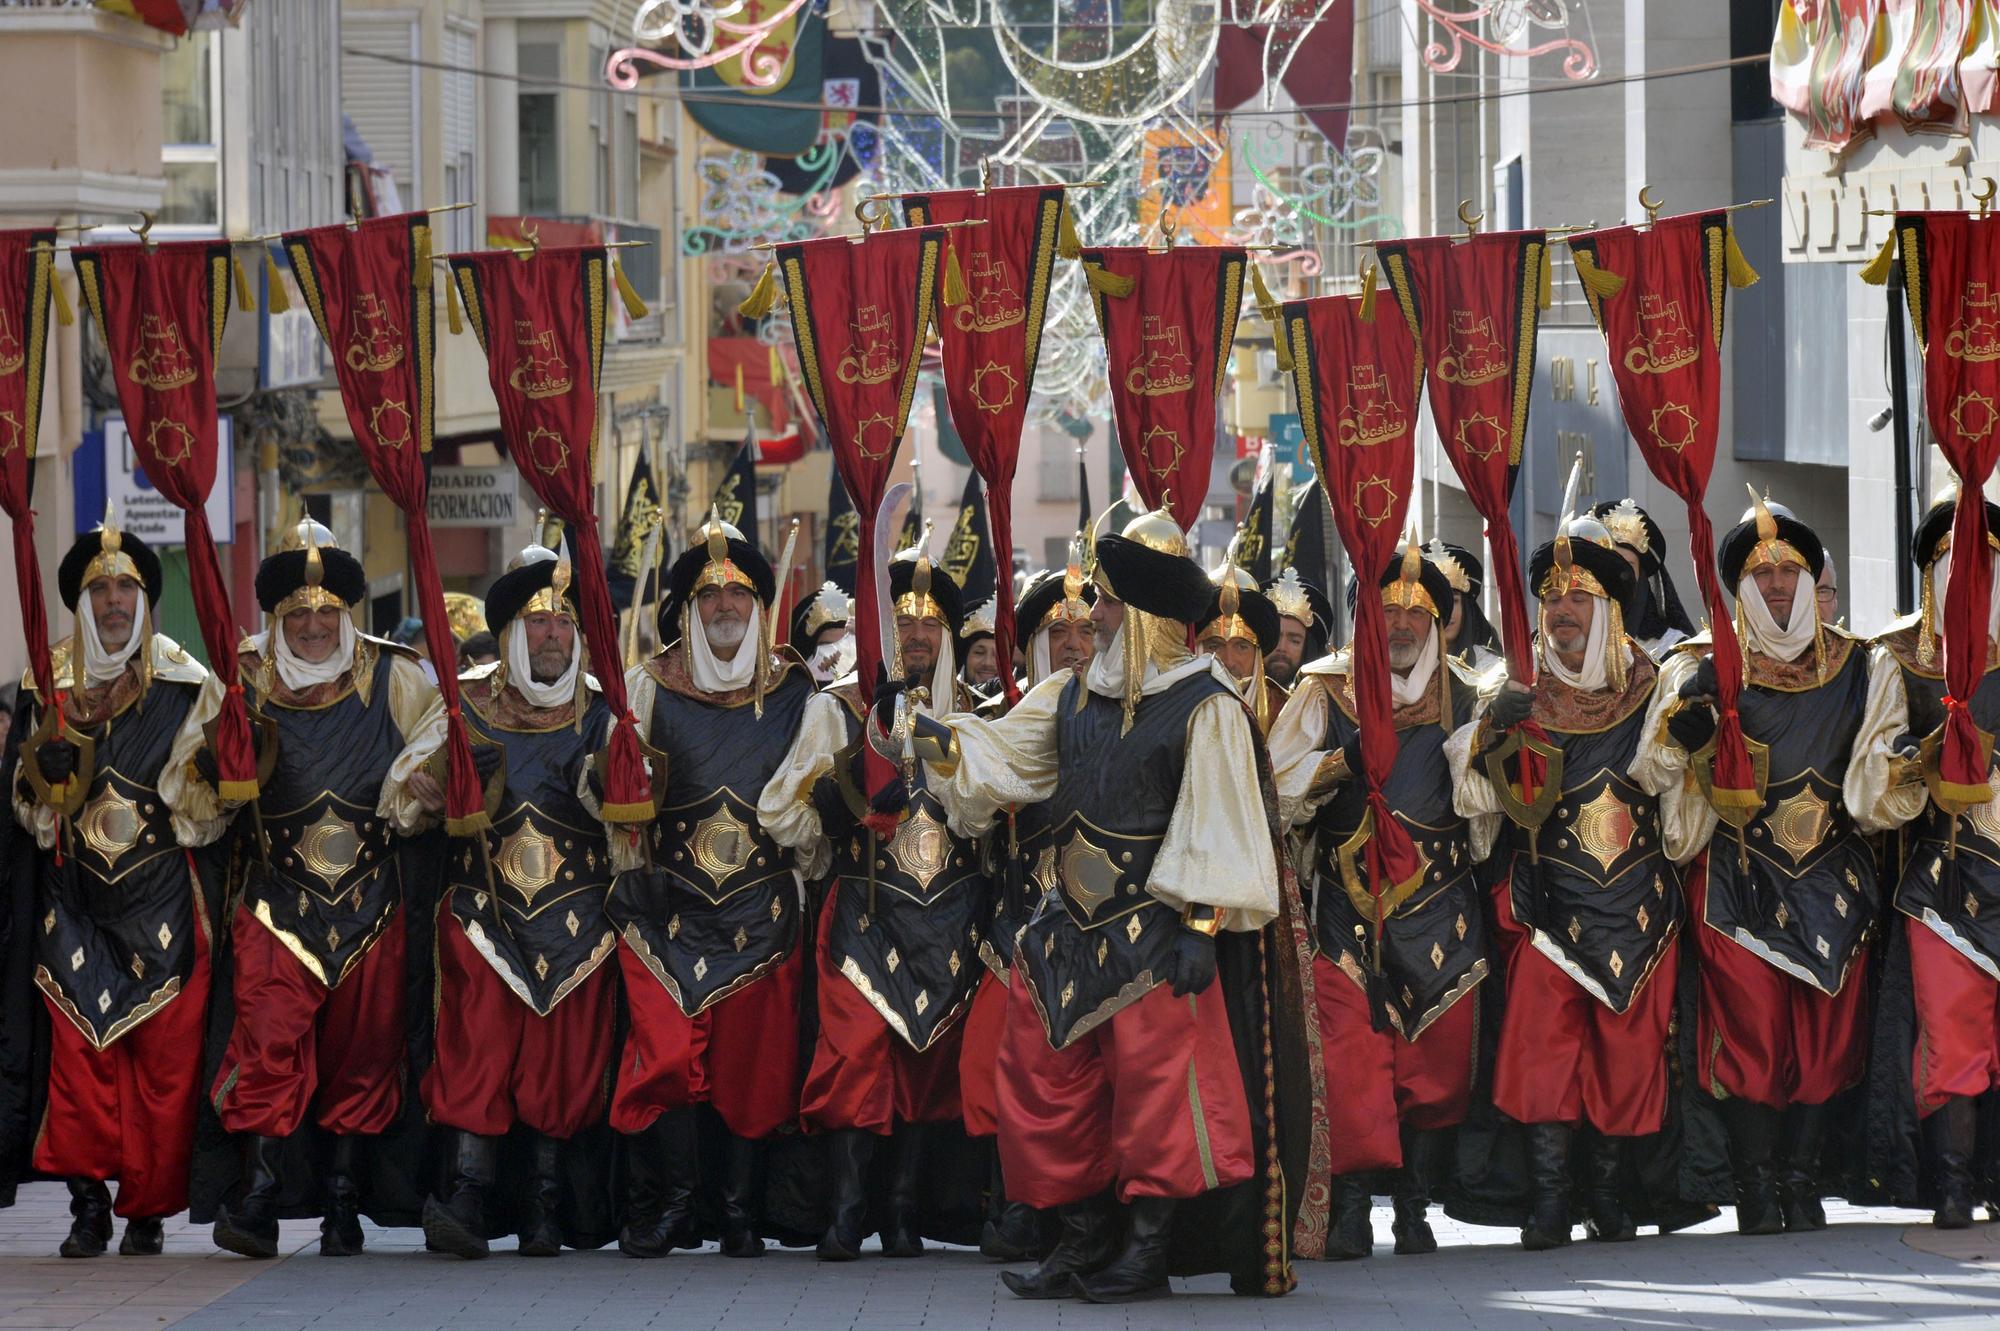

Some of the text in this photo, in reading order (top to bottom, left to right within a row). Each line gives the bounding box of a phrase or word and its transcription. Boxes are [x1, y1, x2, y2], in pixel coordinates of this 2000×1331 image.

[431, 474, 497, 488] DIARIO
[125, 509, 181, 521] Apuestas
[124, 522, 166, 533] Estado
